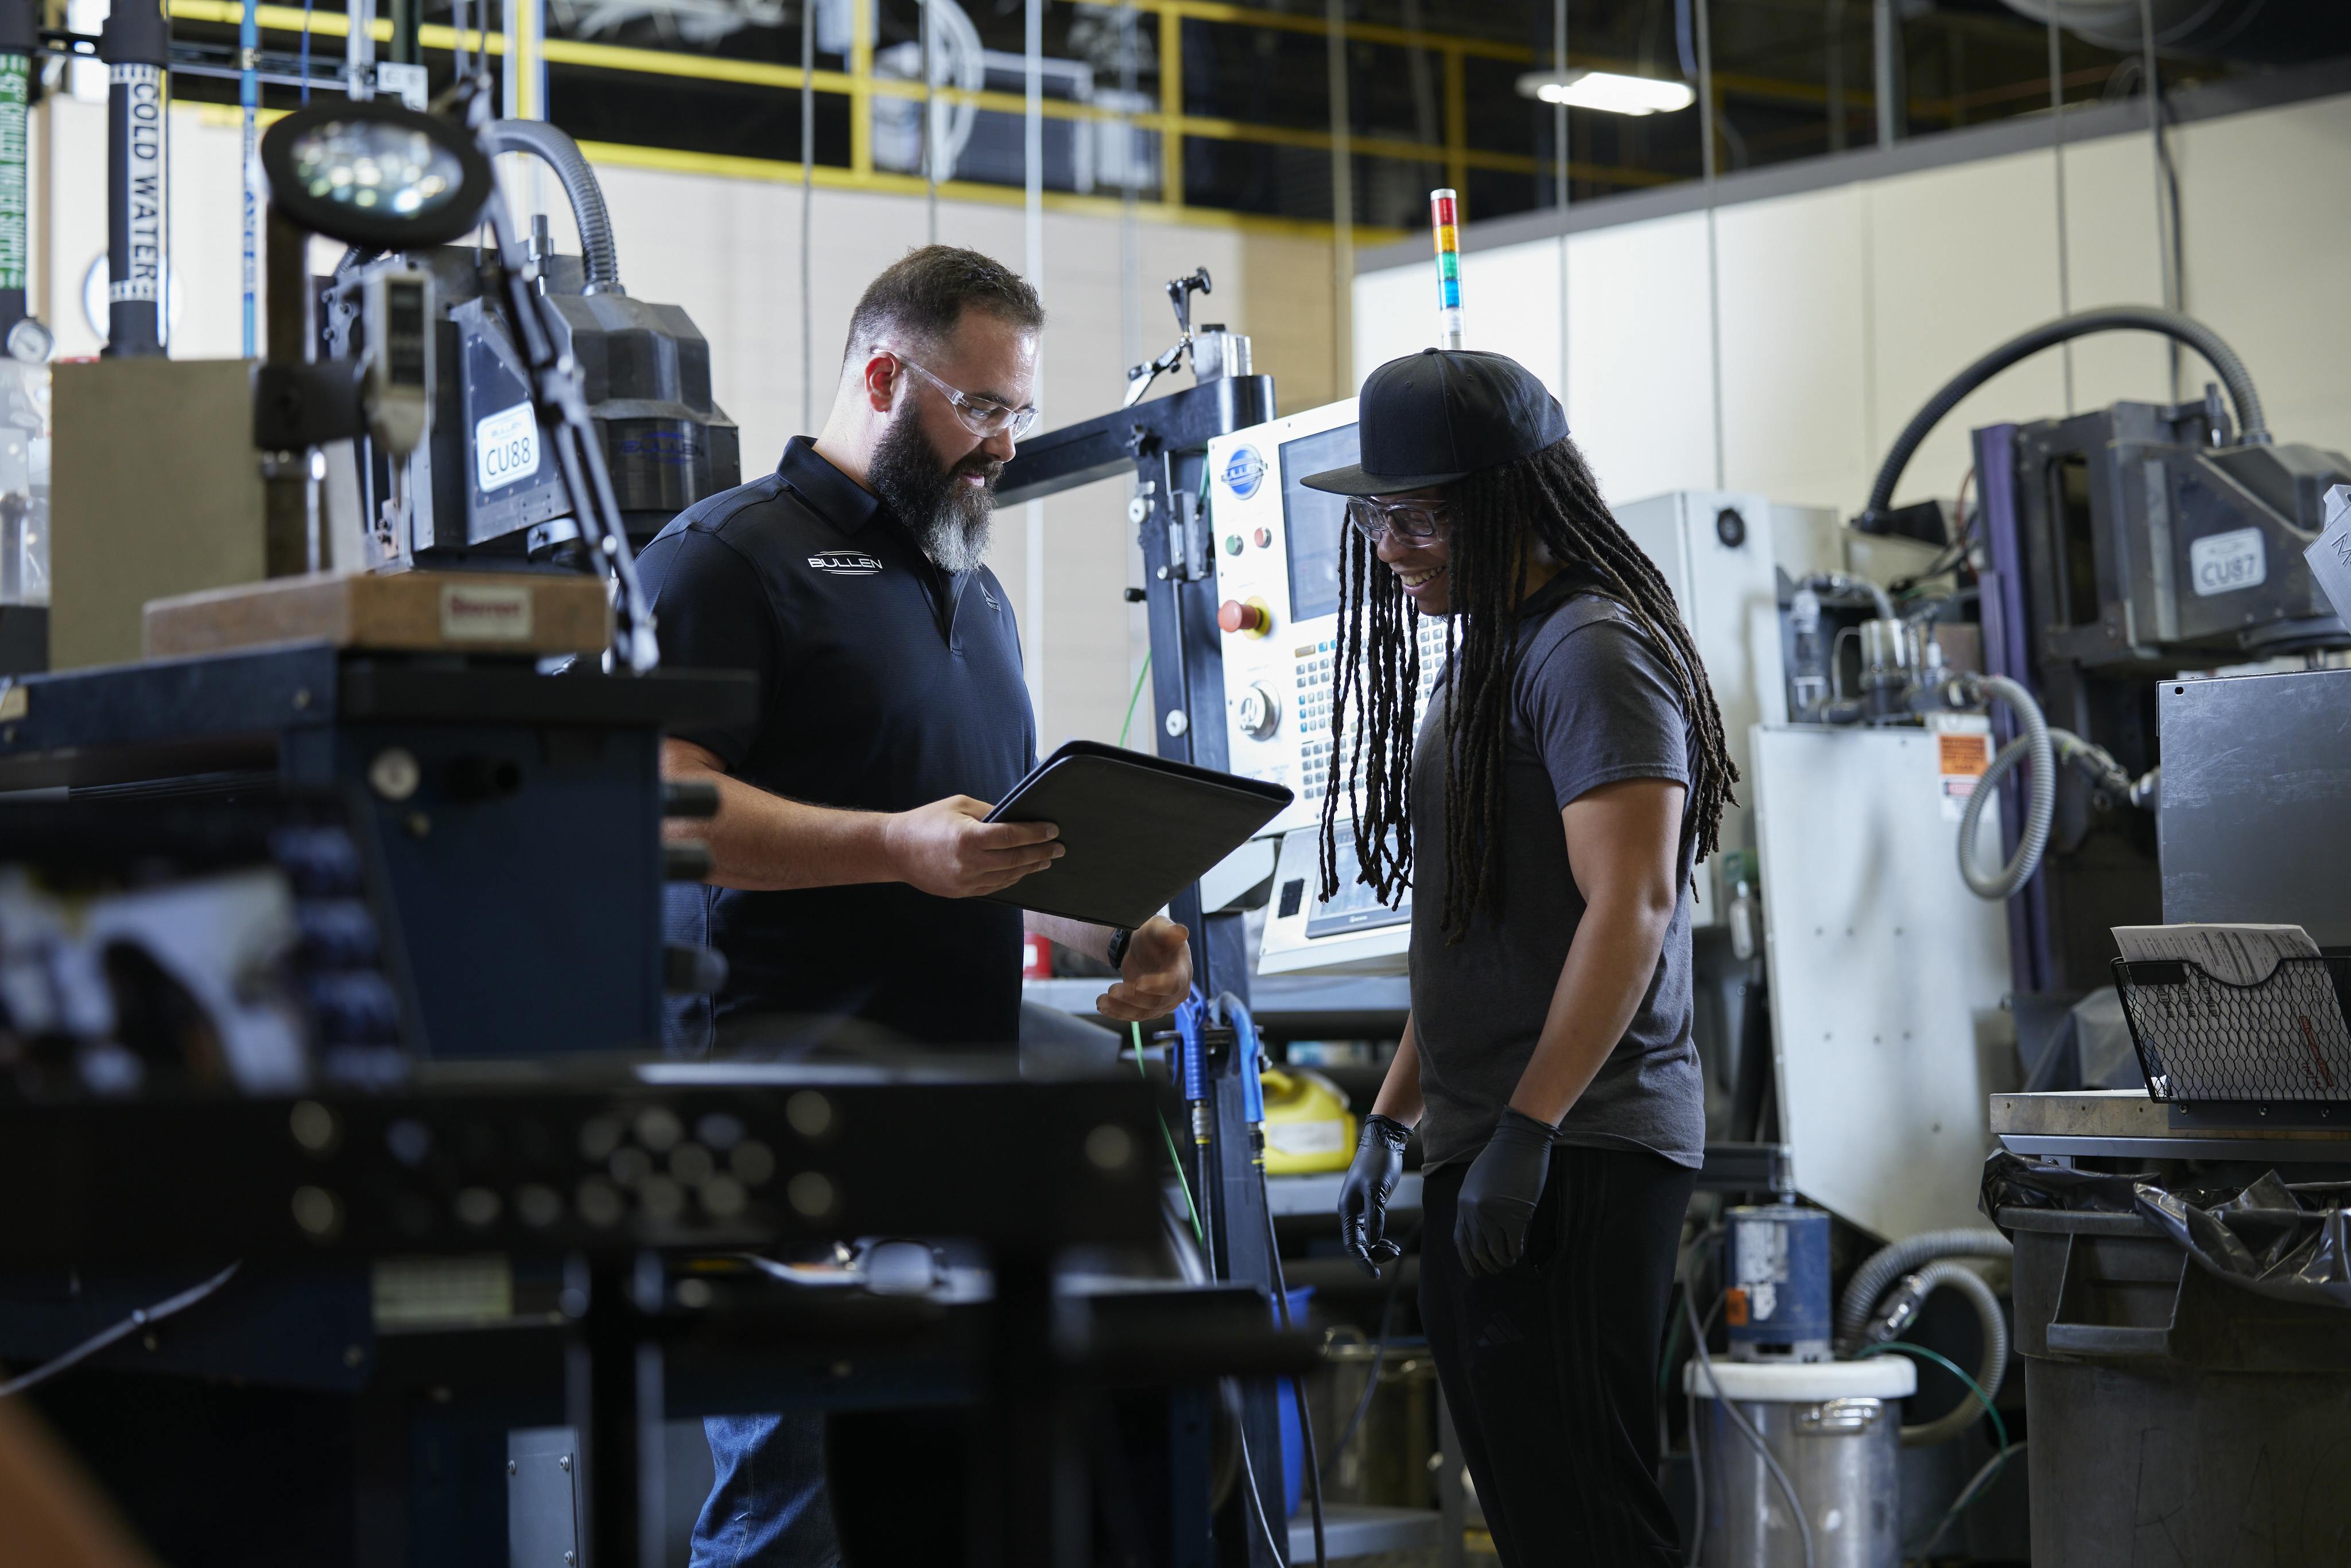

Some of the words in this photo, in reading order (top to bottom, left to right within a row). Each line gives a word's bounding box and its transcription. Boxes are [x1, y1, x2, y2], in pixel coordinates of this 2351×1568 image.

[134, 83, 157, 161] COLD
[134, 176, 157, 279] WATER
[487, 437, 530, 475] CU88
[808, 558, 883, 569] BULLEN
[2331, 531, 2351, 568] M
[2201, 553, 2256, 587] CU87
